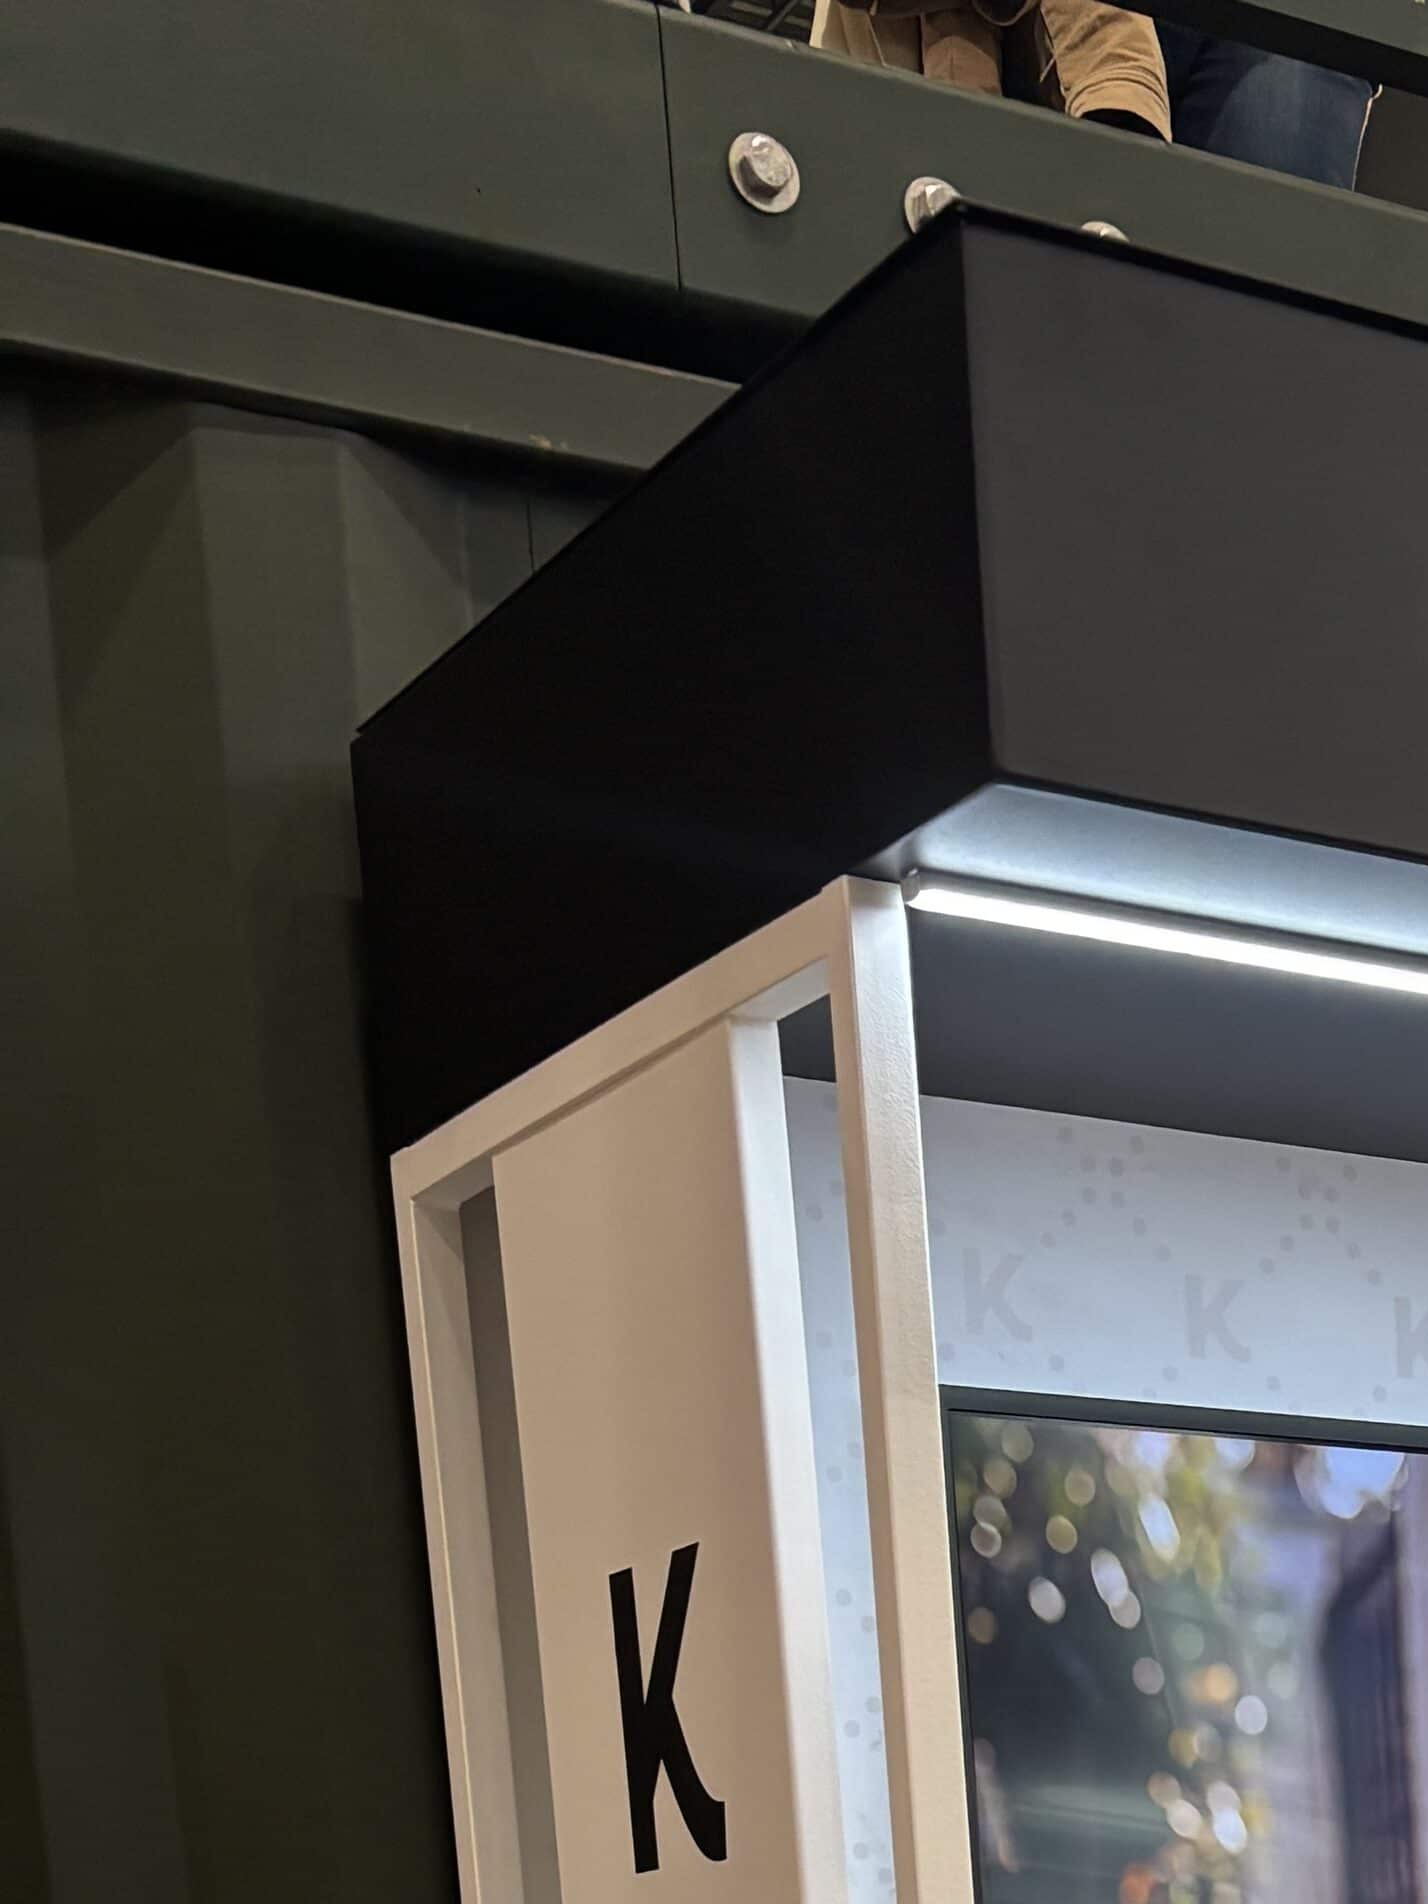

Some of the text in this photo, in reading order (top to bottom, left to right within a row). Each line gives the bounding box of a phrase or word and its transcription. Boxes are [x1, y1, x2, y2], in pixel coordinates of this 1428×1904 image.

[961, 1248, 1033, 1341] K
[1184, 1274, 1252, 1362] K
[608, 1541, 728, 1874] K
